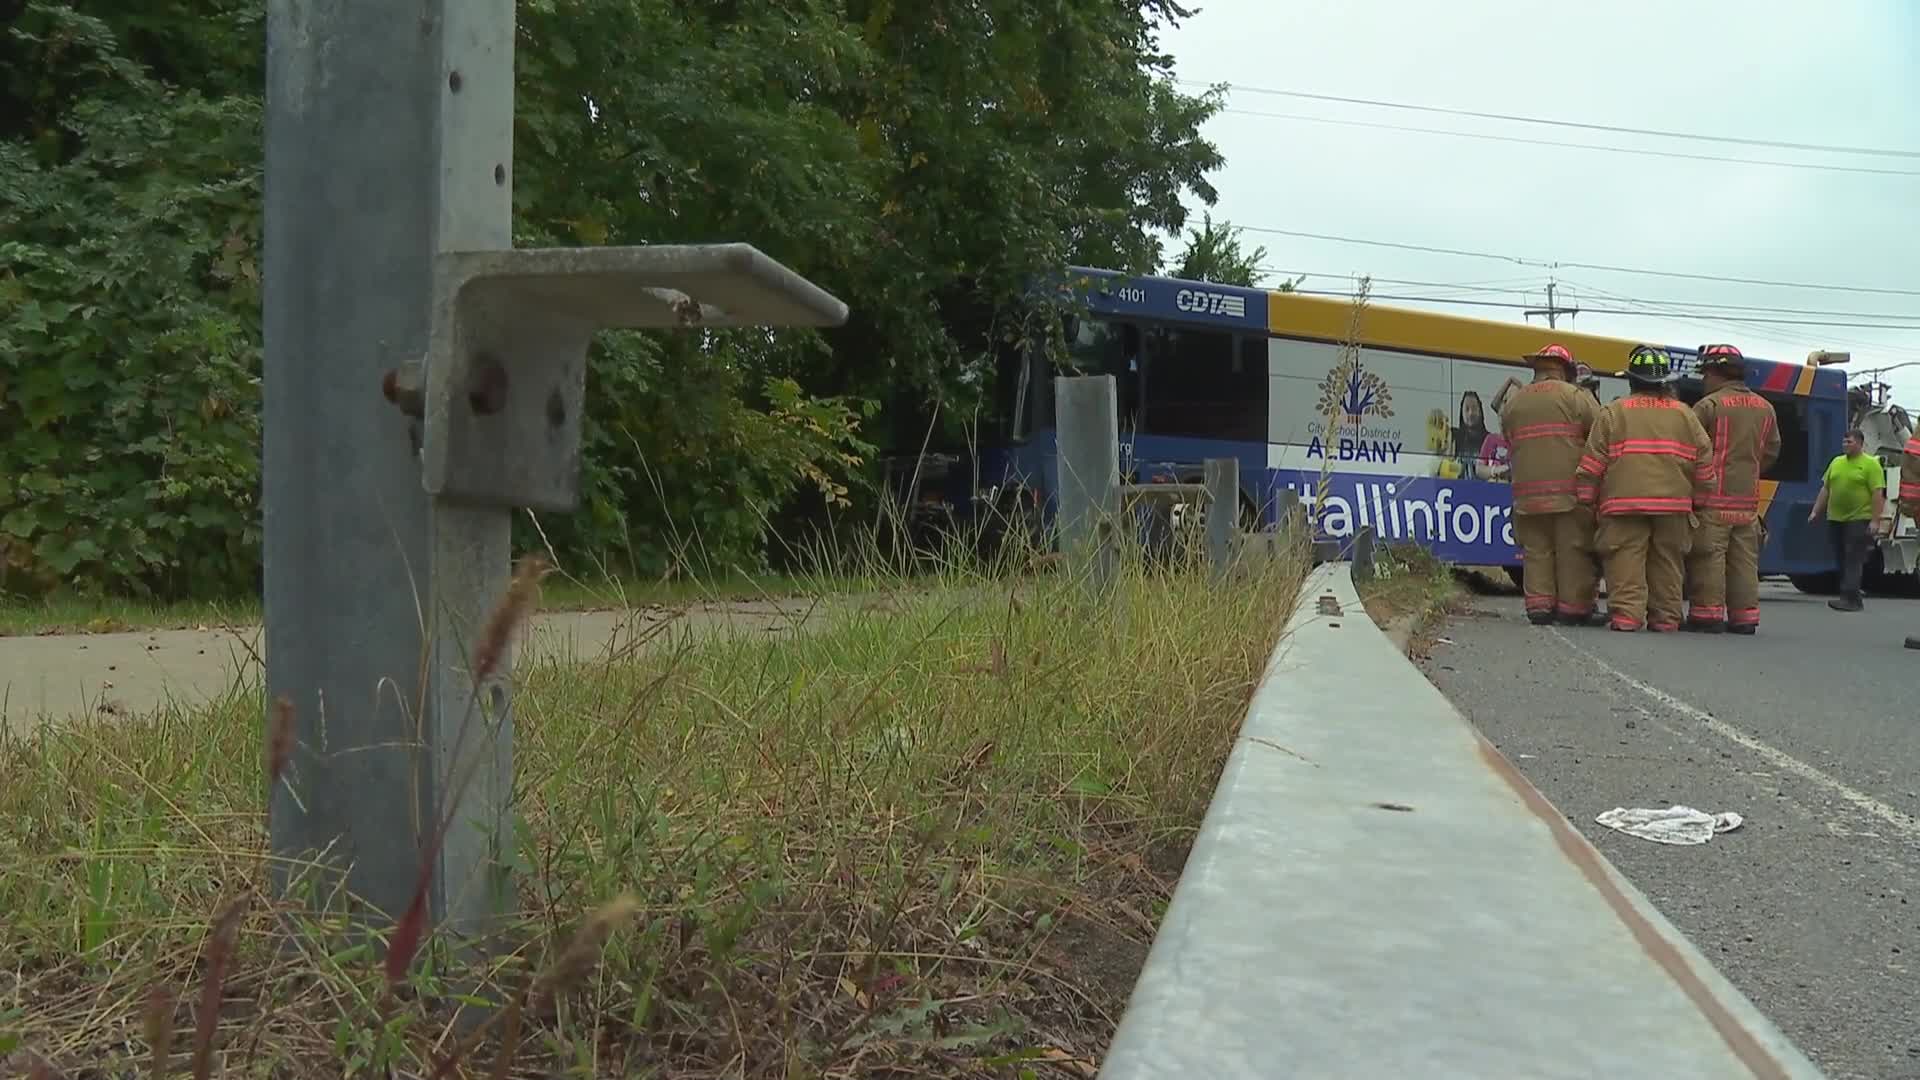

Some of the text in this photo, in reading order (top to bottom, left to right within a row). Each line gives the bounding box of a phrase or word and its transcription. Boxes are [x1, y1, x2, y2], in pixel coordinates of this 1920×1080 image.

[1118, 287, 1145, 303] 4101
[1176, 289, 1245, 318] CDTA
[1307, 422, 1326, 436] City
[1360, 426, 1391, 440] District
[1392, 430, 1402, 441] of
[1288, 482, 1516, 546] tallinfor
